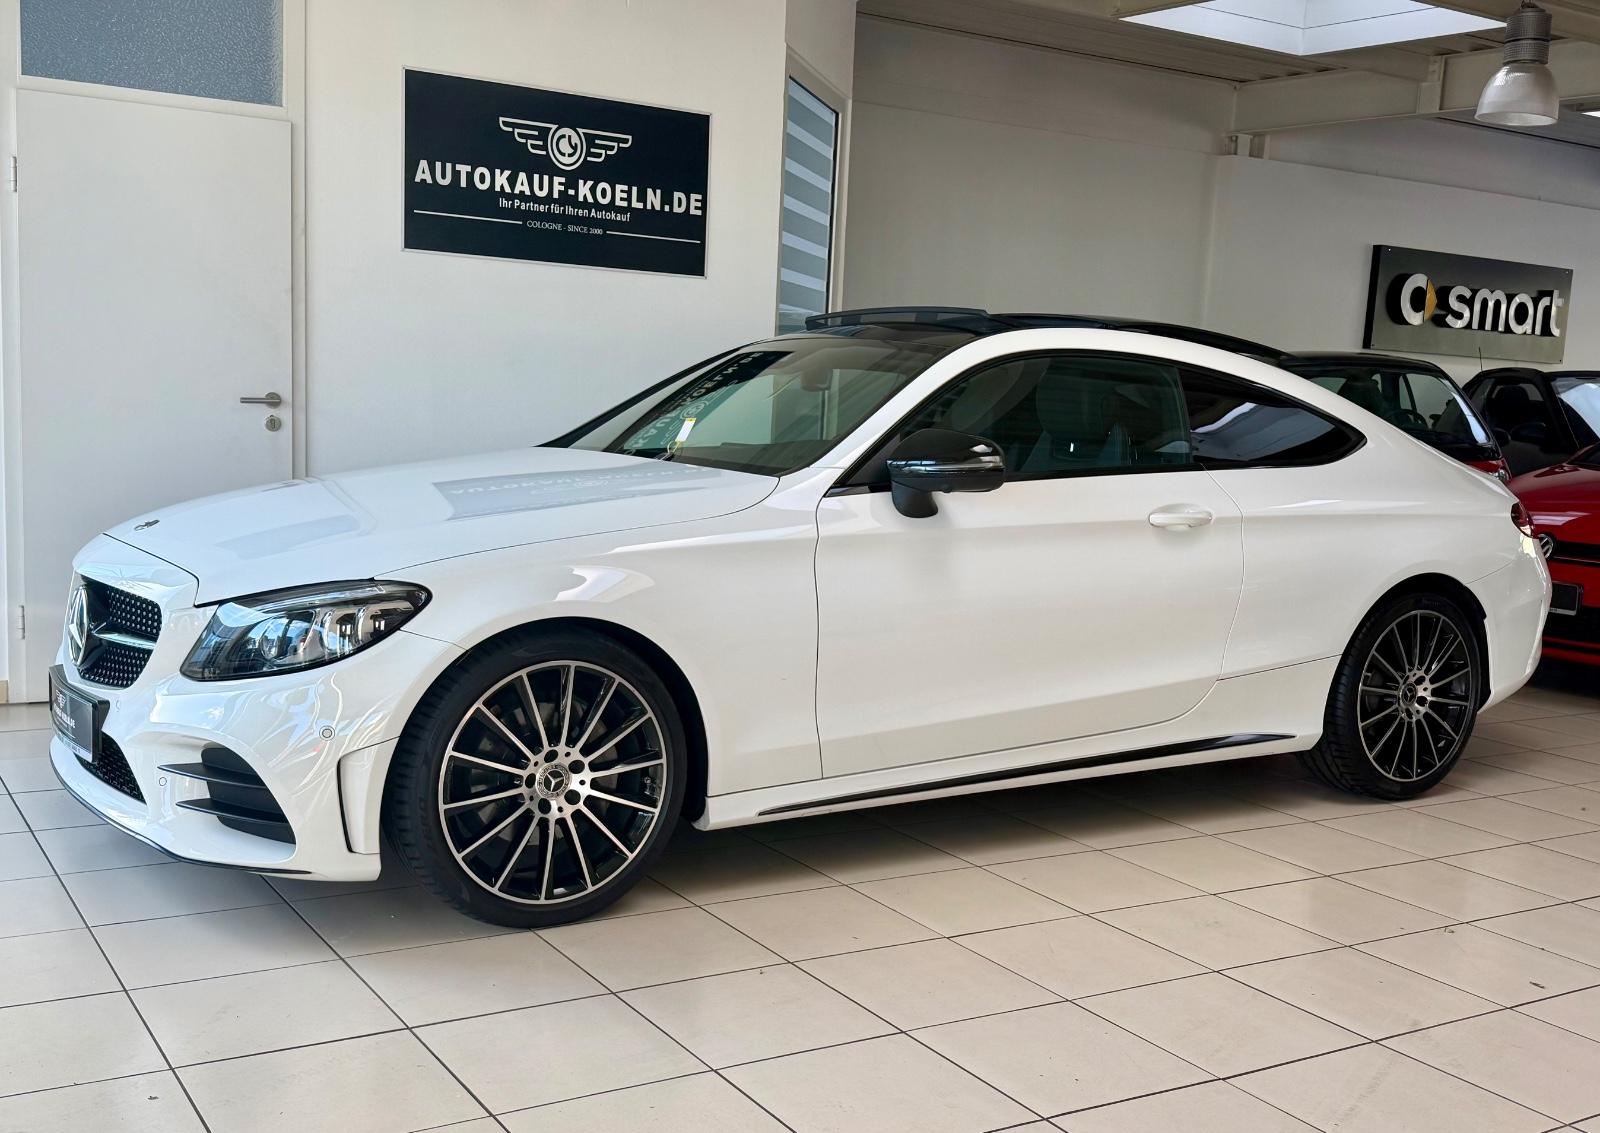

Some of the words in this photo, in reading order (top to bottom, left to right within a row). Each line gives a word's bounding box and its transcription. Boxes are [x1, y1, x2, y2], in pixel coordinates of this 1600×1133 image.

[414, 159, 703, 216] AUTOKAUF-KOELN.DE
[499, 197, 513, 209] Ihr
[514, 199, 549, 213] Partner
[550, 203, 563, 214] für
[565, 205, 589, 217] Ihren
[590, 208, 631, 222] Autokauf
[526, 220, 563, 231] COLOGNE
[567, 224, 588, 234] SINCE
[1445, 285, 1564, 337] smart
